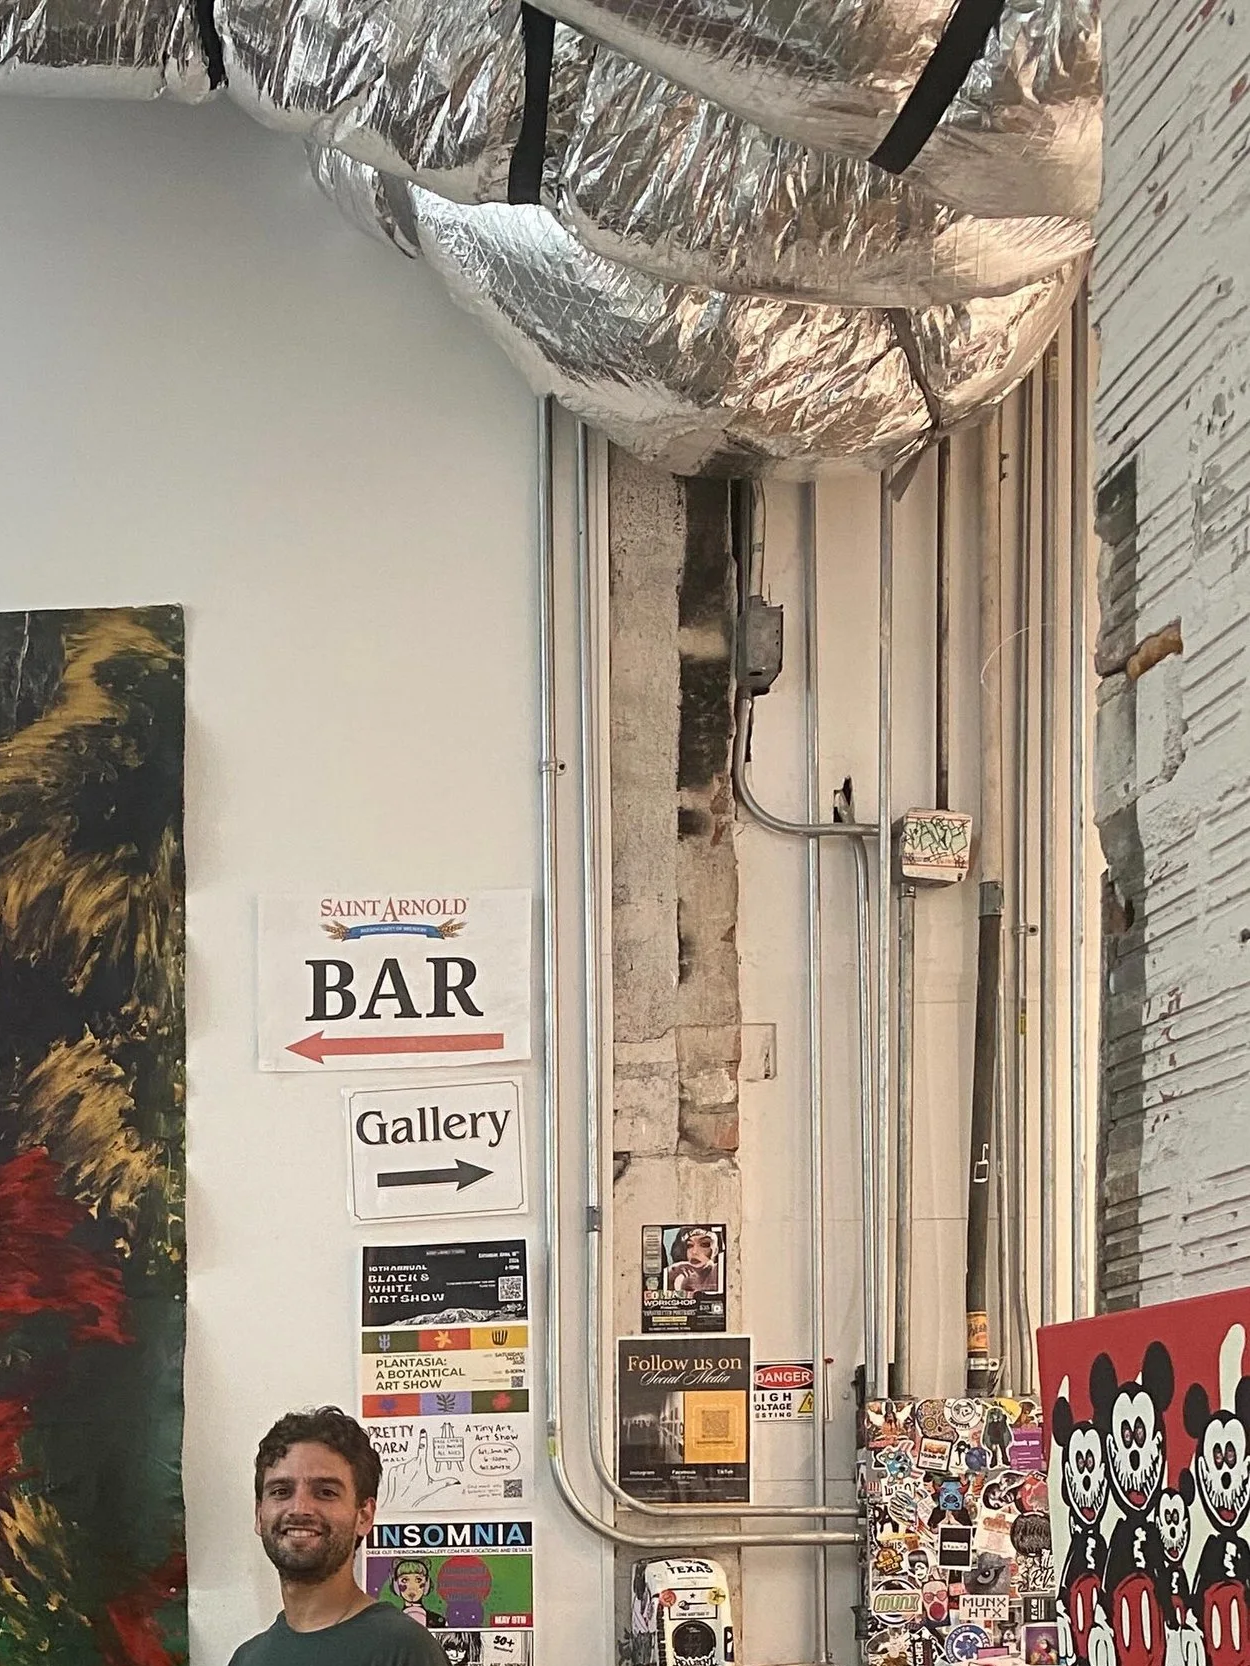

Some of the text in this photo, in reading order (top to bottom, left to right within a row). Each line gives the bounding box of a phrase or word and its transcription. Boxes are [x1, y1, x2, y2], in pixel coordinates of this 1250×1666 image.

[321, 896, 467, 922] SAINT ARNOLD
[305, 957, 484, 1022] BAR
[355, 1106, 511, 1148] Gallery
[368, 1274, 417, 1283] BLACK
[368, 1284, 413, 1293] WHITE
[368, 1293, 445, 1303] ART SHOW
[376, 1357, 447, 1369] PLANTASIA:
[627, 1354, 742, 1371] Follow us on
[376, 1367, 466, 1380] A BOTANTICAL
[640, 1368, 731, 1386] Social Media
[755, 1371, 810, 1383] DANGER
[376, 1379, 443, 1391] ART SHOW
[754, 1403, 792, 1411] OLTAGE
[369, 1425, 414, 1439] PRETTY
[465, 1425, 472, 1433] A
[473, 1425, 493, 1434] Tiny
[494, 1433, 519, 1441] Show
[372, 1441, 409, 1454] DARN
[373, 1523, 526, 1547] INSOMNIA
[667, 1565, 713, 1574] TEXAS
[962, 1597, 1006, 1607] MUNX
[969, 1608, 1002, 1618] HTX
[494, 1615, 510, 1624] MAY
[493, 1635, 515, 1648] 50+
